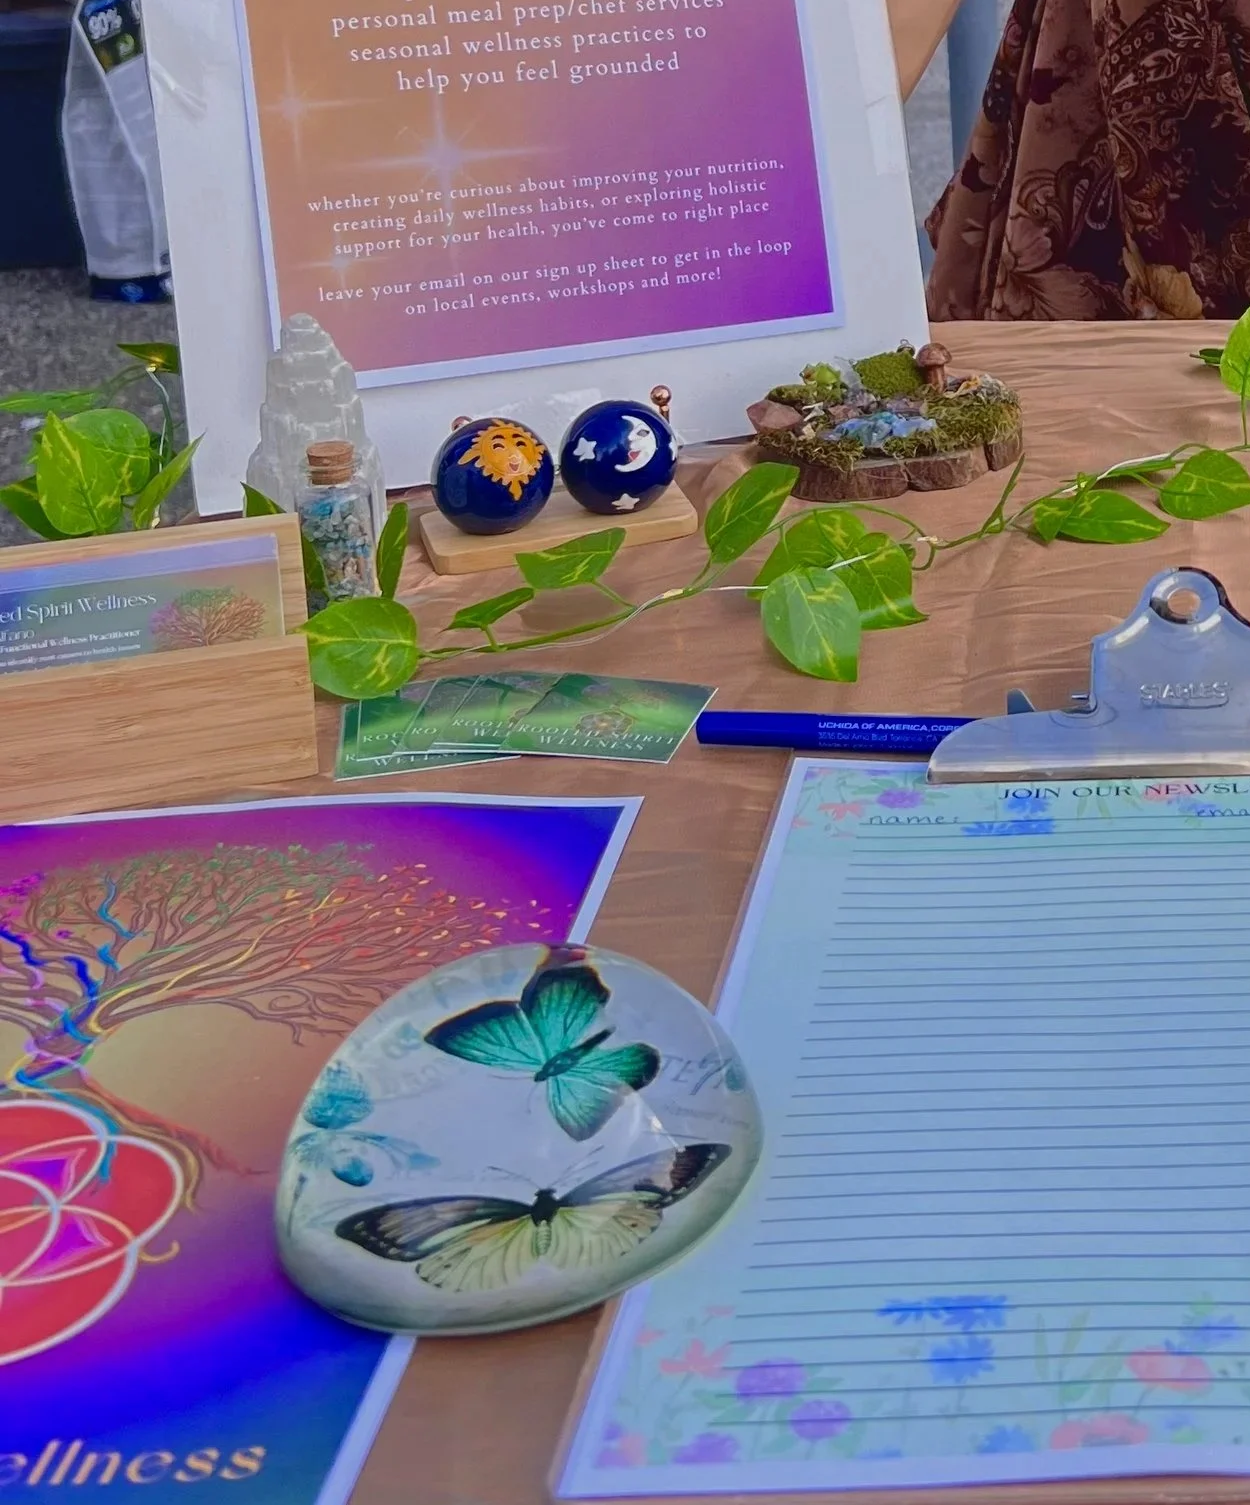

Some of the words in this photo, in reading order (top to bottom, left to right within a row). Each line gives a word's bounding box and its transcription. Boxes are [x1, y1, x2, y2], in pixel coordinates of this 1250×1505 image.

[330, 3, 437, 39] personal
[446, 0, 503, 24] meal
[349, 34, 453, 63] seasonal
[461, 30, 563, 55] wellness
[571, 24, 676, 54] practices
[683, 25, 707, 40] to
[396, 67, 450, 96] help
[459, 70, 505, 93] you
[515, 58, 559, 82] feel
[568, 50, 681, 85] grounded
[307, 192, 381, 212] whether
[386, 188, 443, 210] you're
[448, 183, 513, 200] curious
[518, 176, 566, 193] about
[571, 168, 660, 191] improving
[663, 166, 702, 184] your
[706, 157, 785, 176] nutrition,
[332, 214, 407, 233] creating
[413, 207, 455, 228] daily
[461, 201, 534, 220] wellness
[538, 195, 595, 213] habits,
[600, 195, 619, 207] or
[624, 185, 704, 210] exploring
[707, 178, 767, 197] holistic
[334, 238, 402, 259] support
[408, 231, 434, 248] for
[440, 230, 481, 249] your
[486, 220, 546, 240] health,
[550, 216, 607, 239] you've
[612, 213, 656, 228] come
[661, 210, 679, 223] to
[683, 202, 724, 224] right
[728, 199, 770, 220] place
[318, 286, 364, 303] leave
[370, 282, 413, 302] your
[418, 271, 466, 292] email
[472, 273, 494, 286] on
[500, 270, 530, 283] our
[534, 264, 571, 282] sign
[576, 262, 598, 278] up
[602, 255, 646, 272] sheet
[650, 254, 668, 267] to
[673, 250, 700, 269] get
[704, 246, 722, 261] in
[726, 241, 752, 258] the
[756, 239, 793, 257] loop
[404, 303, 427, 316] on
[432, 292, 476, 313] local
[481, 291, 542, 307] events,
[546, 278, 636, 300] workshops
[640, 270, 670, 289] and
[675, 265, 722, 285] more!
[26, 601, 74, 624] Spirit
[77, 594, 157, 614] Wellness
[539, 735, 645, 752] WELLNESS
[610, 730, 676, 746] SPIRIT
[818, 721, 860, 730] UCHIDA
[861, 722, 876, 730] OF
[999, 786, 1061, 800] JOIN
[1072, 785, 1131, 797] OUR
[0, 1438, 267, 1486] ellness
